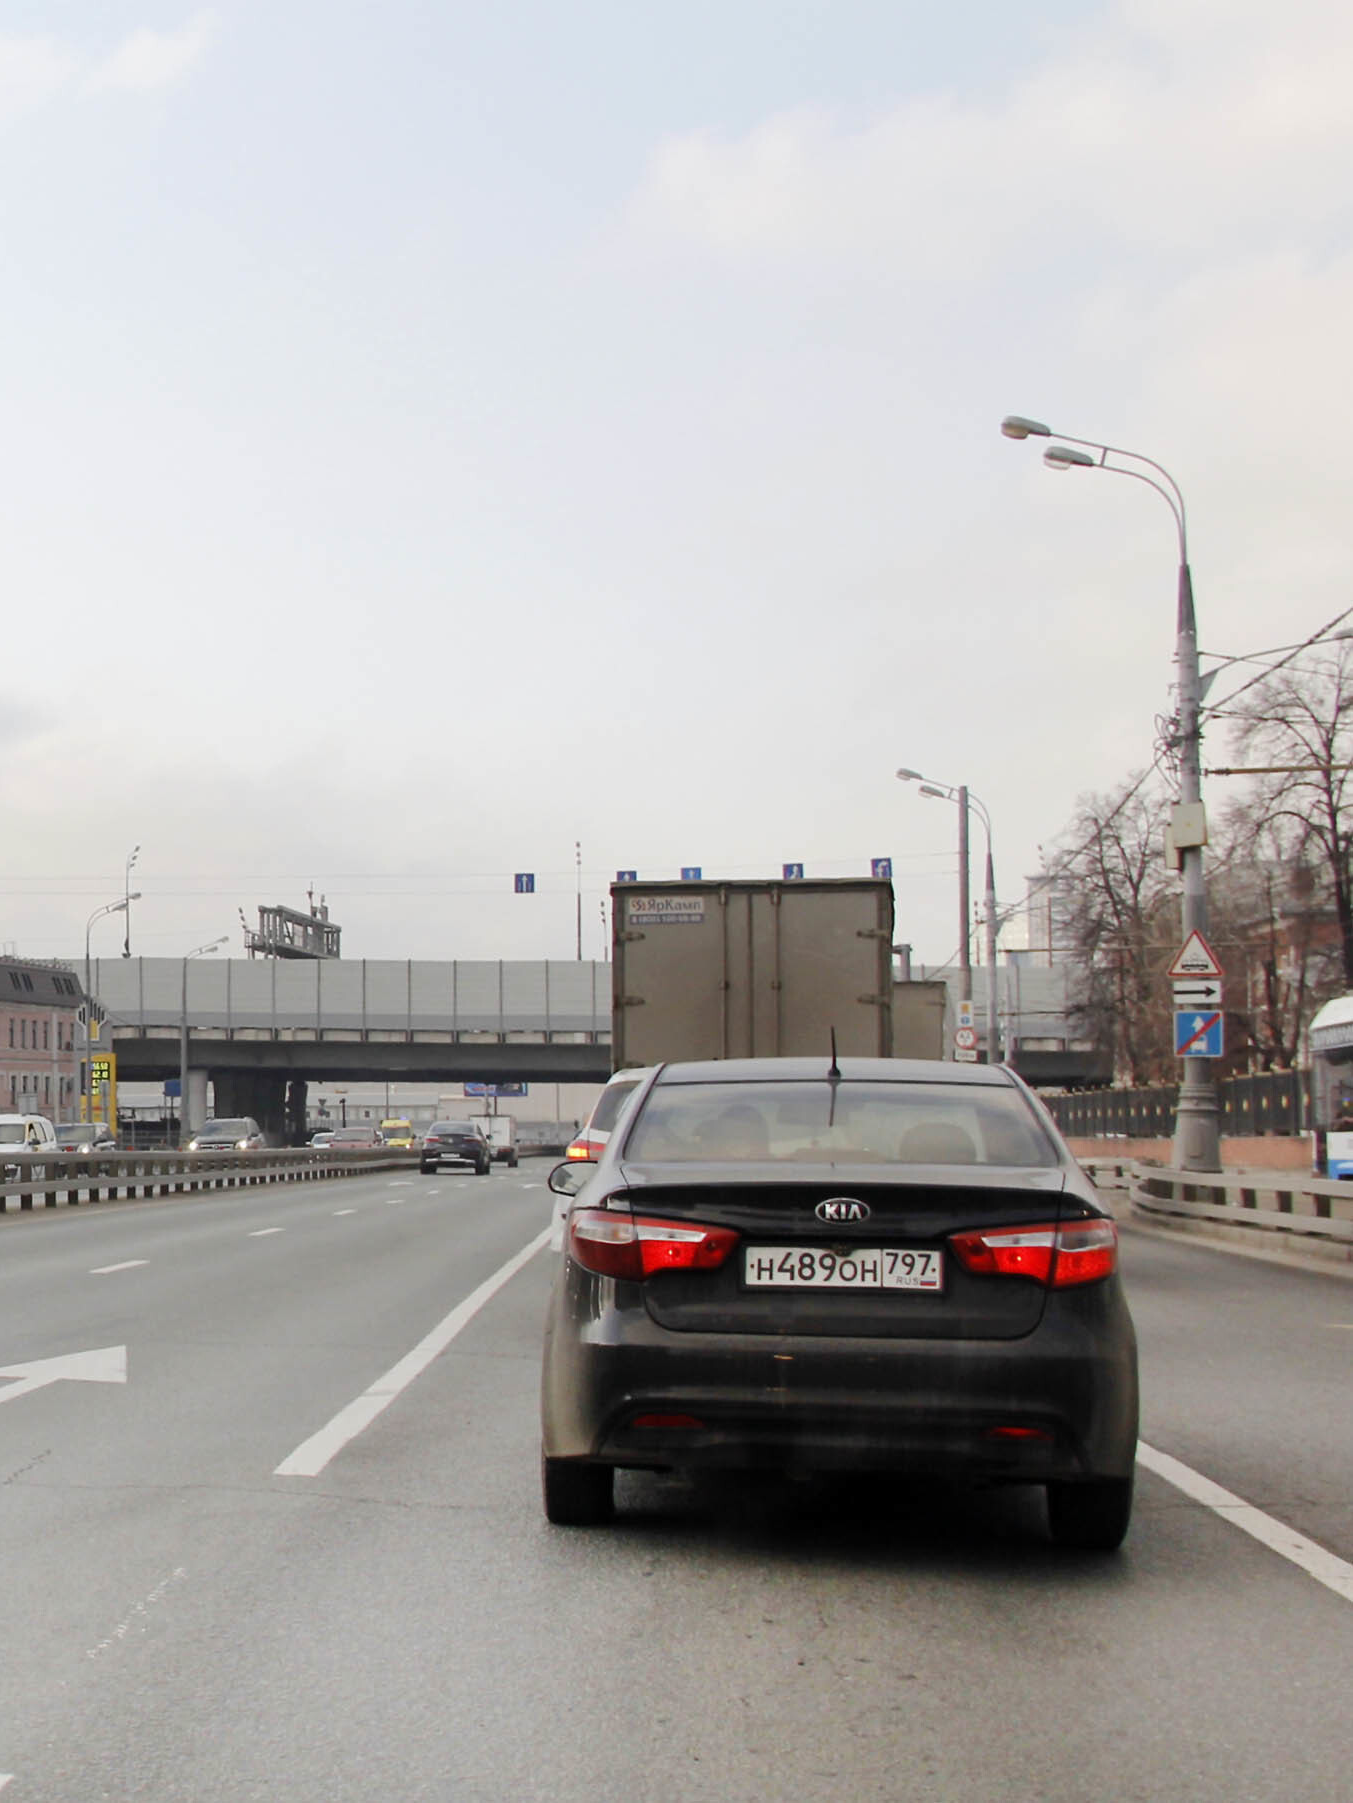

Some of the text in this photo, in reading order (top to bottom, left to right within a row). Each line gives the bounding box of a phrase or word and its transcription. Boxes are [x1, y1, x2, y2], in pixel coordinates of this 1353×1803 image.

[825, 1203, 862, 1219] KIA
[885, 1252, 932, 1276] 797
[896, 1276, 919, 1286] RUS
